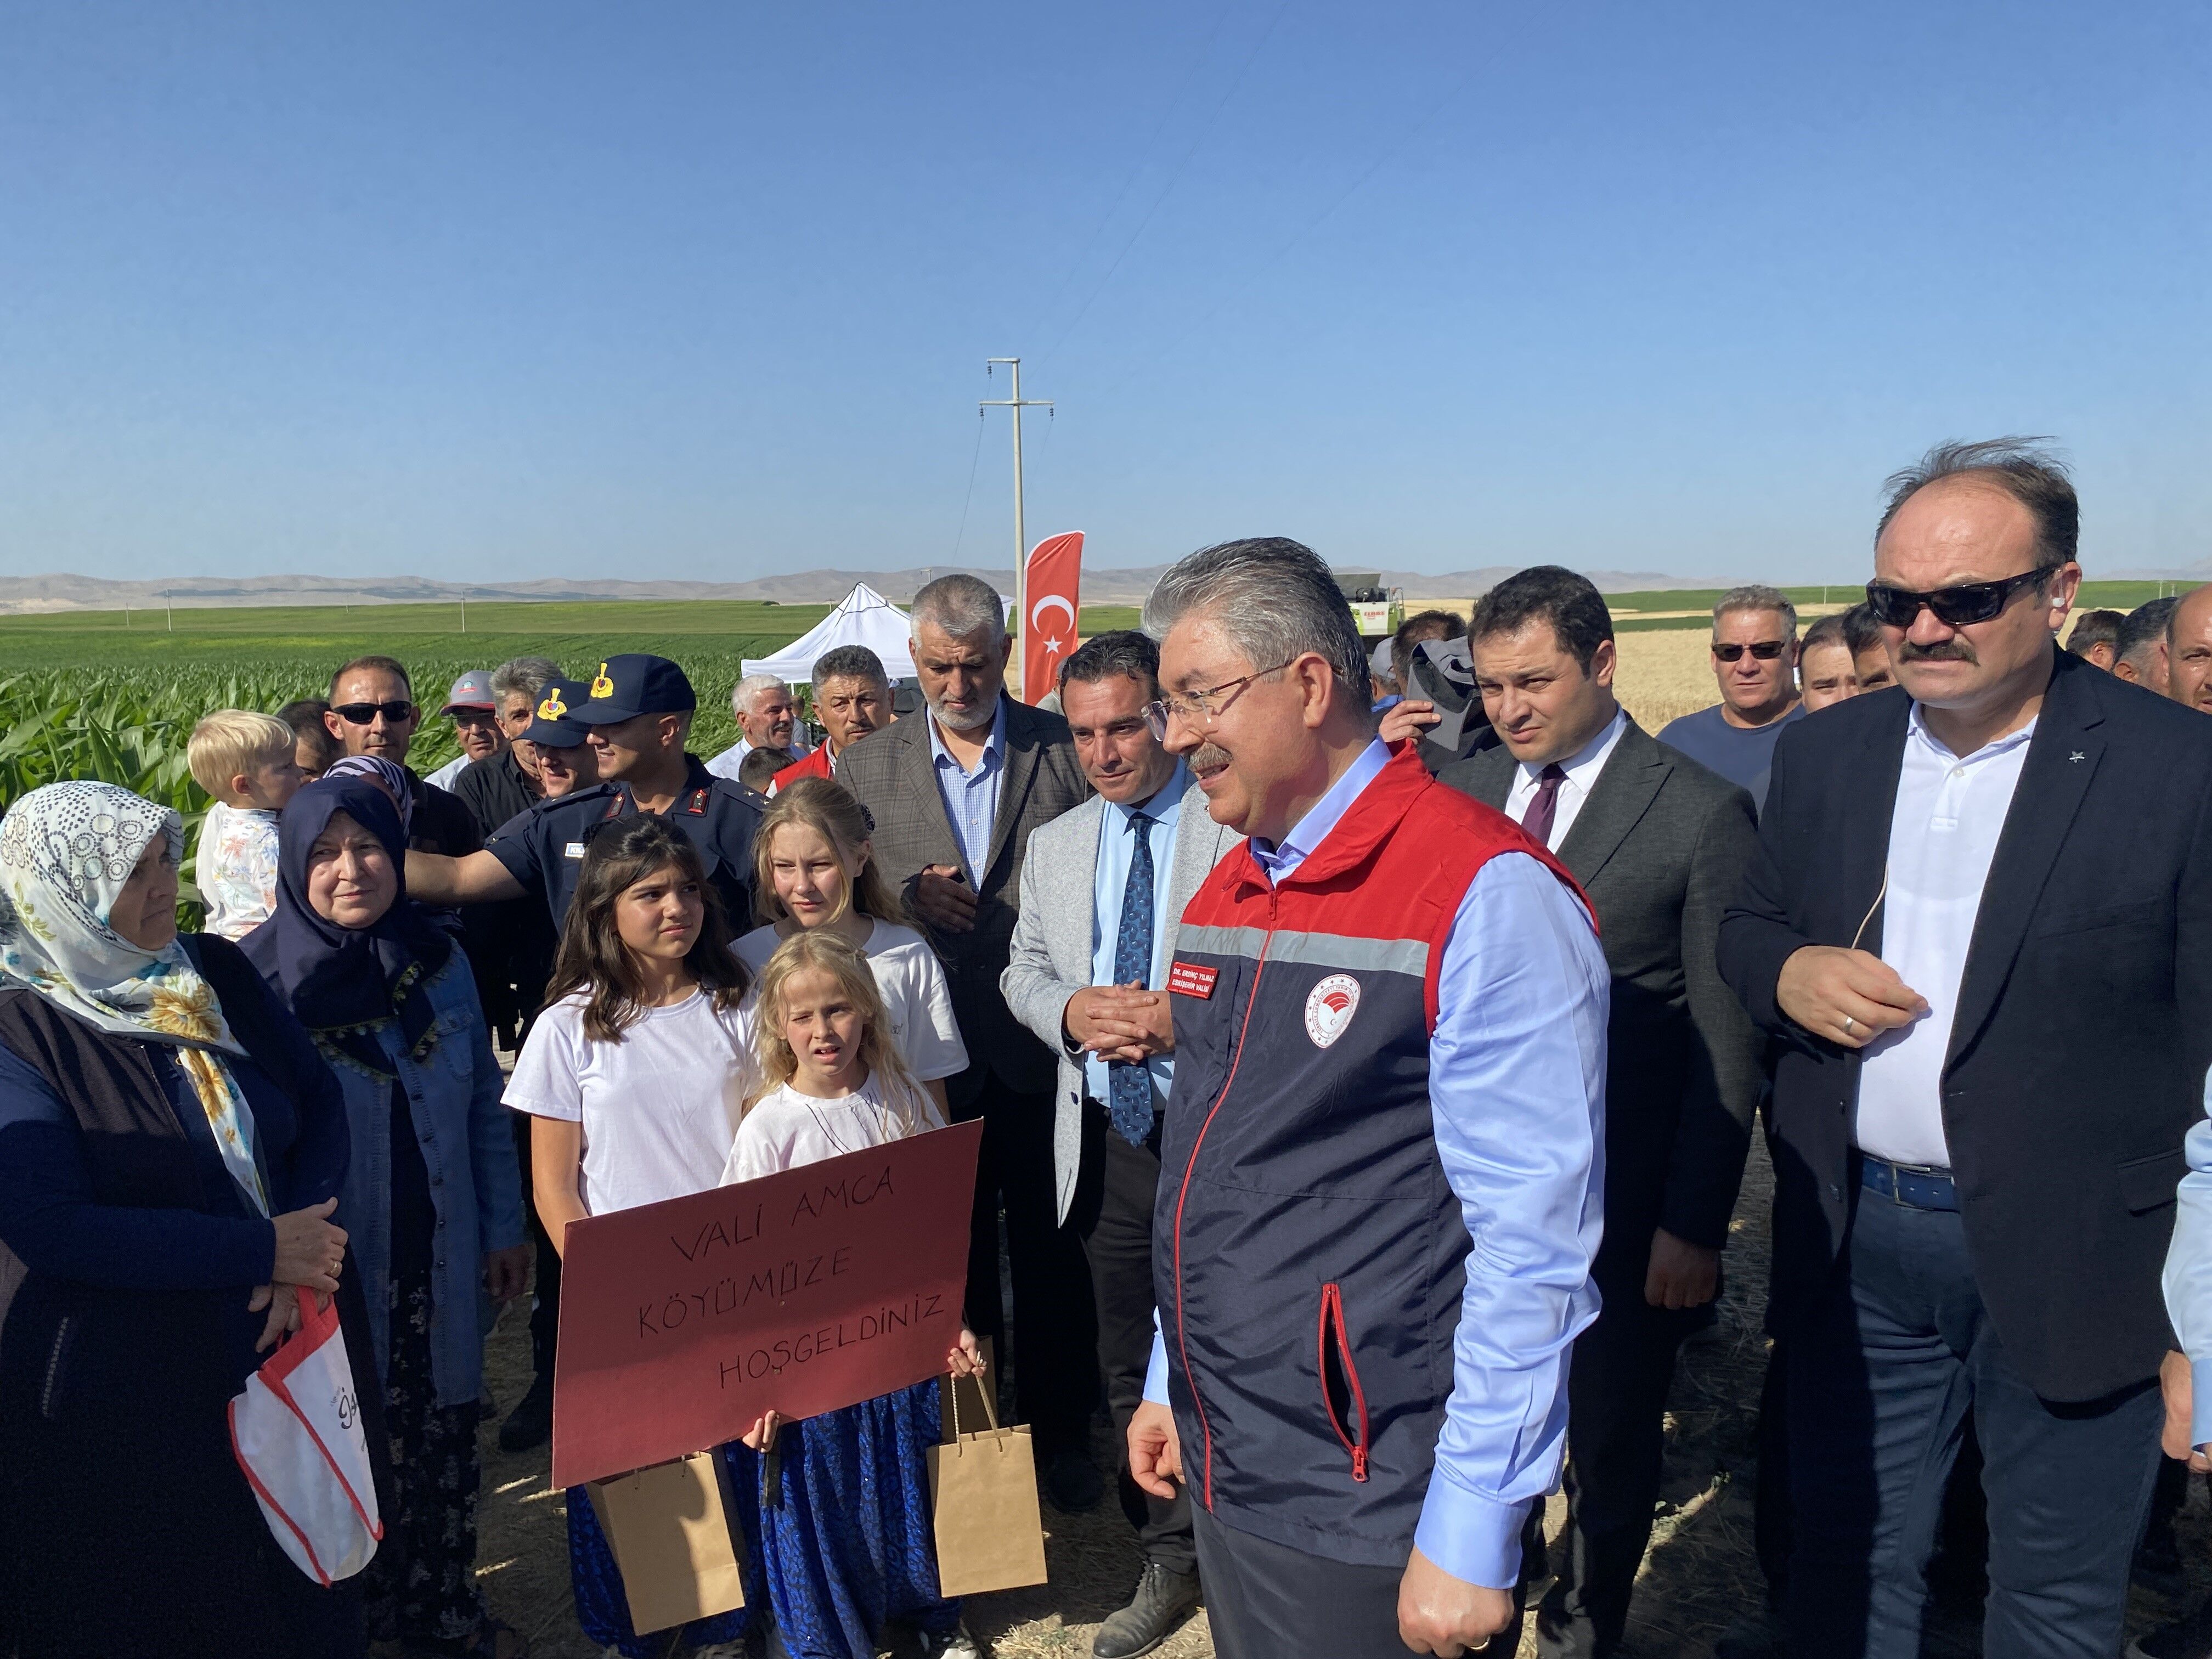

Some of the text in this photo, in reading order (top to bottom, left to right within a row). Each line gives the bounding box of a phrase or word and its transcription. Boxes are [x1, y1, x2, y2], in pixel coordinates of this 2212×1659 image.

[1171, 978, 1210, 992] ESKİŞEHİR VALİSİ
[1199, 973, 1215, 982] YILMAZ
[791, 1165, 893, 1227] AMCA
[638, 1246, 853, 1338] KÖYÜMÜZE
[720, 1293, 945, 1389] HOŞGELDİNİZ
